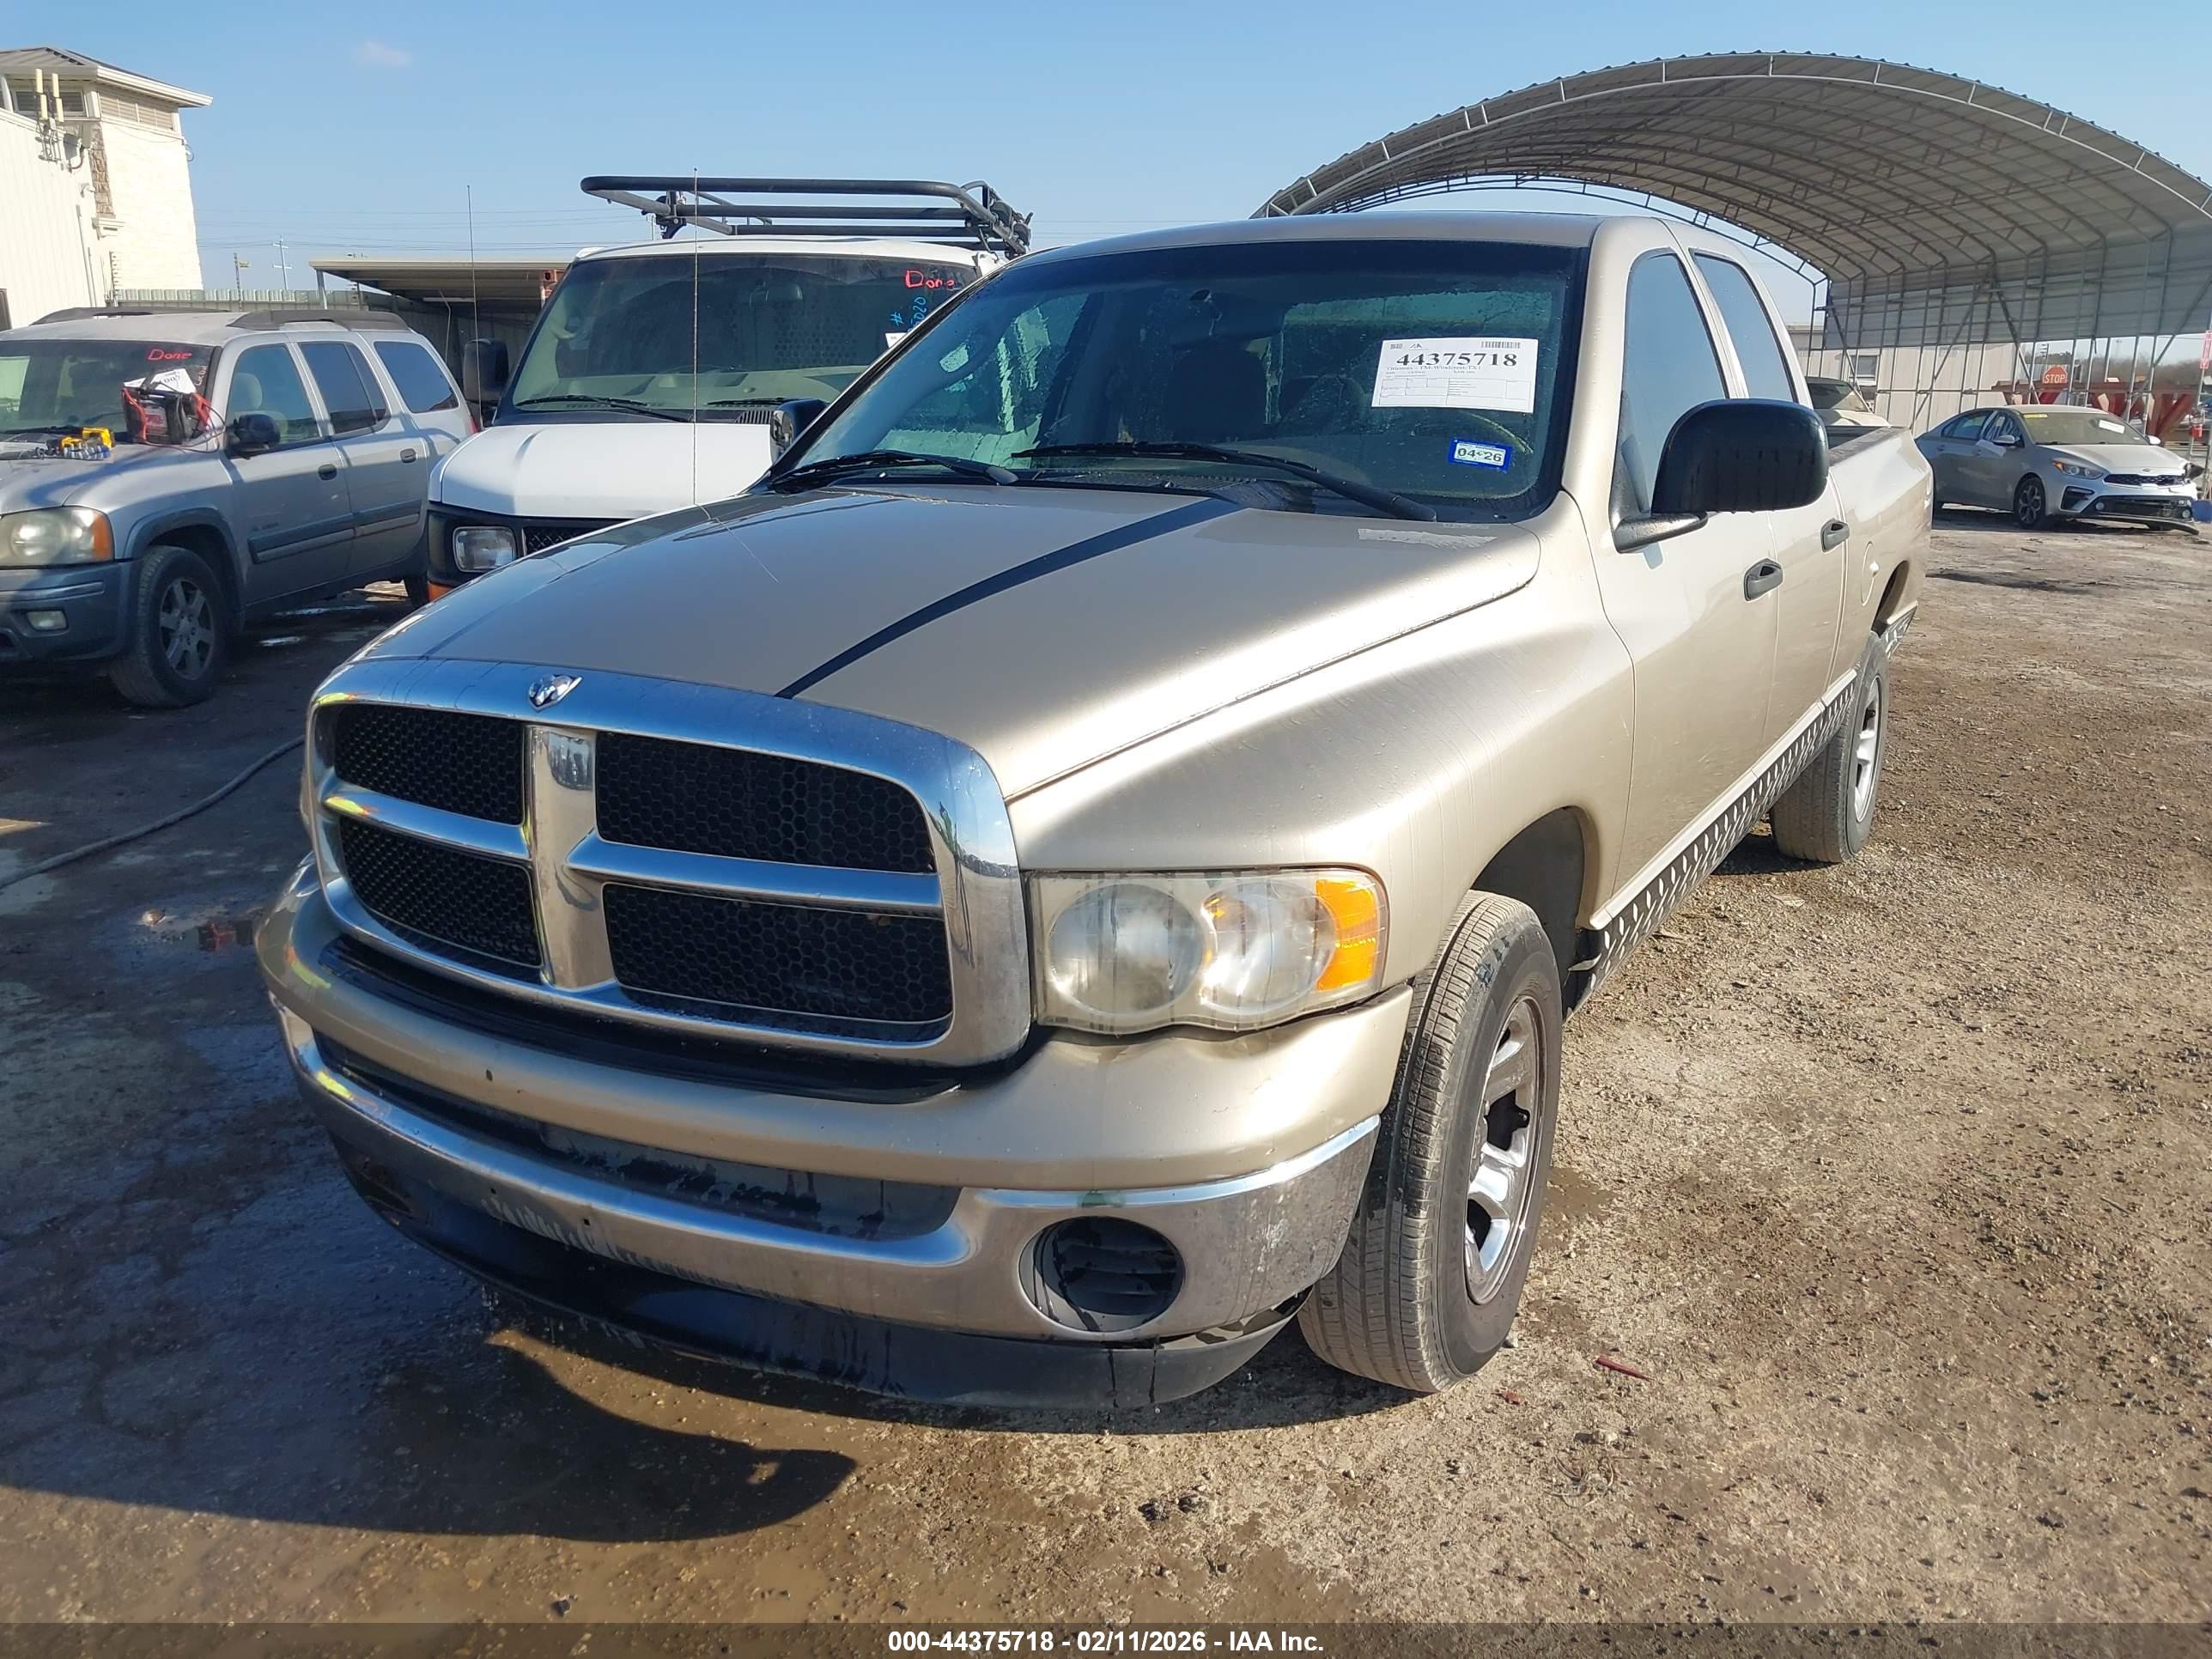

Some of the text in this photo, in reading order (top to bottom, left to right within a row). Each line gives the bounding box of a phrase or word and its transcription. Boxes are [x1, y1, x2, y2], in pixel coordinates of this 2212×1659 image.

[905, 270, 956, 289] Done
[148, 349, 192, 361] Done
[1396, 353, 1518, 367] 44375718
[2045, 374, 2066, 384] STOP
[1458, 448, 1502, 462] 04 26
